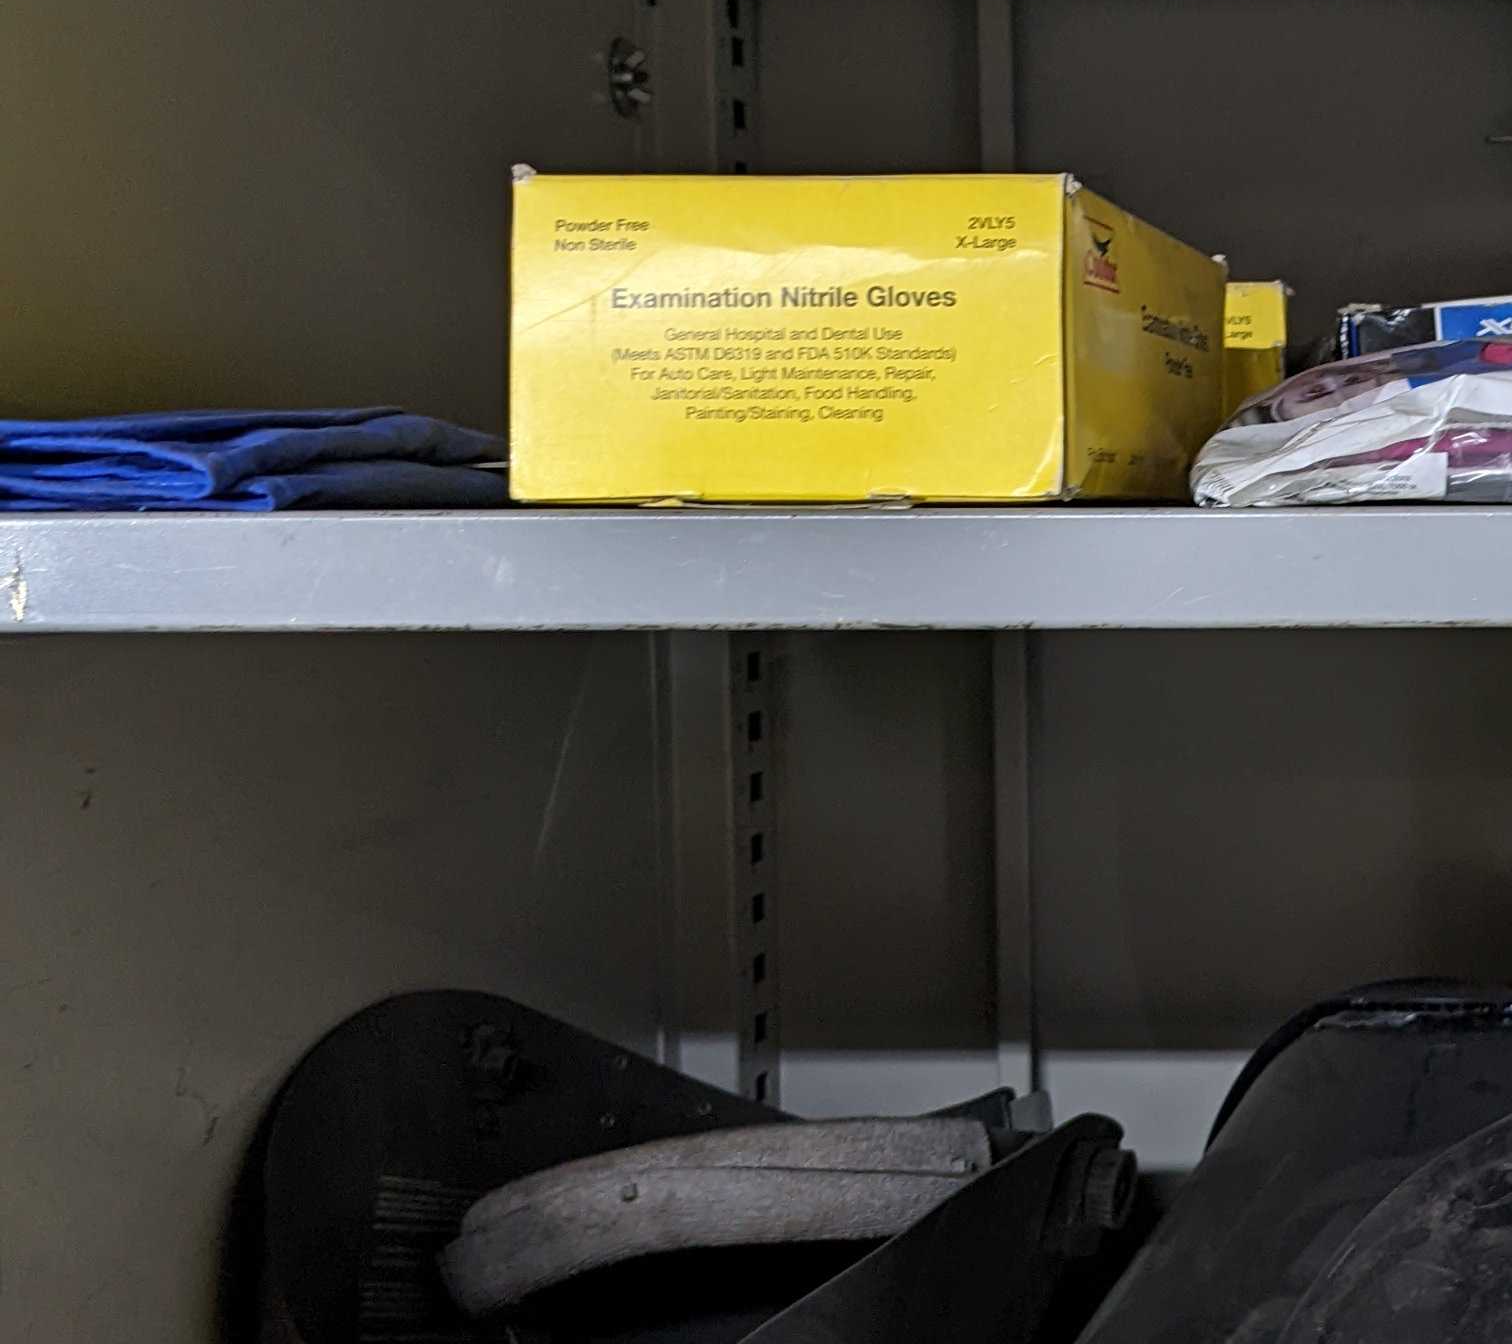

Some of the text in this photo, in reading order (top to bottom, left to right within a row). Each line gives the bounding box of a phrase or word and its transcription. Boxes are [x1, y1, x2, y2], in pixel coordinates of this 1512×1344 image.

[554, 217, 651, 233] Powder Free
[967, 215, 1017, 230] 2VLY5
[553, 237, 638, 252] Non Sterile
[954, 235, 1018, 252] X-Large
[610, 285, 957, 308] Examination Nitrile Gloves
[663, 327, 903, 344] General Hospital and Dental Use
[612, 346, 957, 362] (Meets ASTM D6319 and FDA 510K Standards)
[630, 366, 937, 384] For Auto Care, Light Maintenance, Repair,
[650, 386, 918, 404] Janitorial/Sanitation, Food Handling,
[685, 405, 884, 423] Painting/Staining, Cleaning
